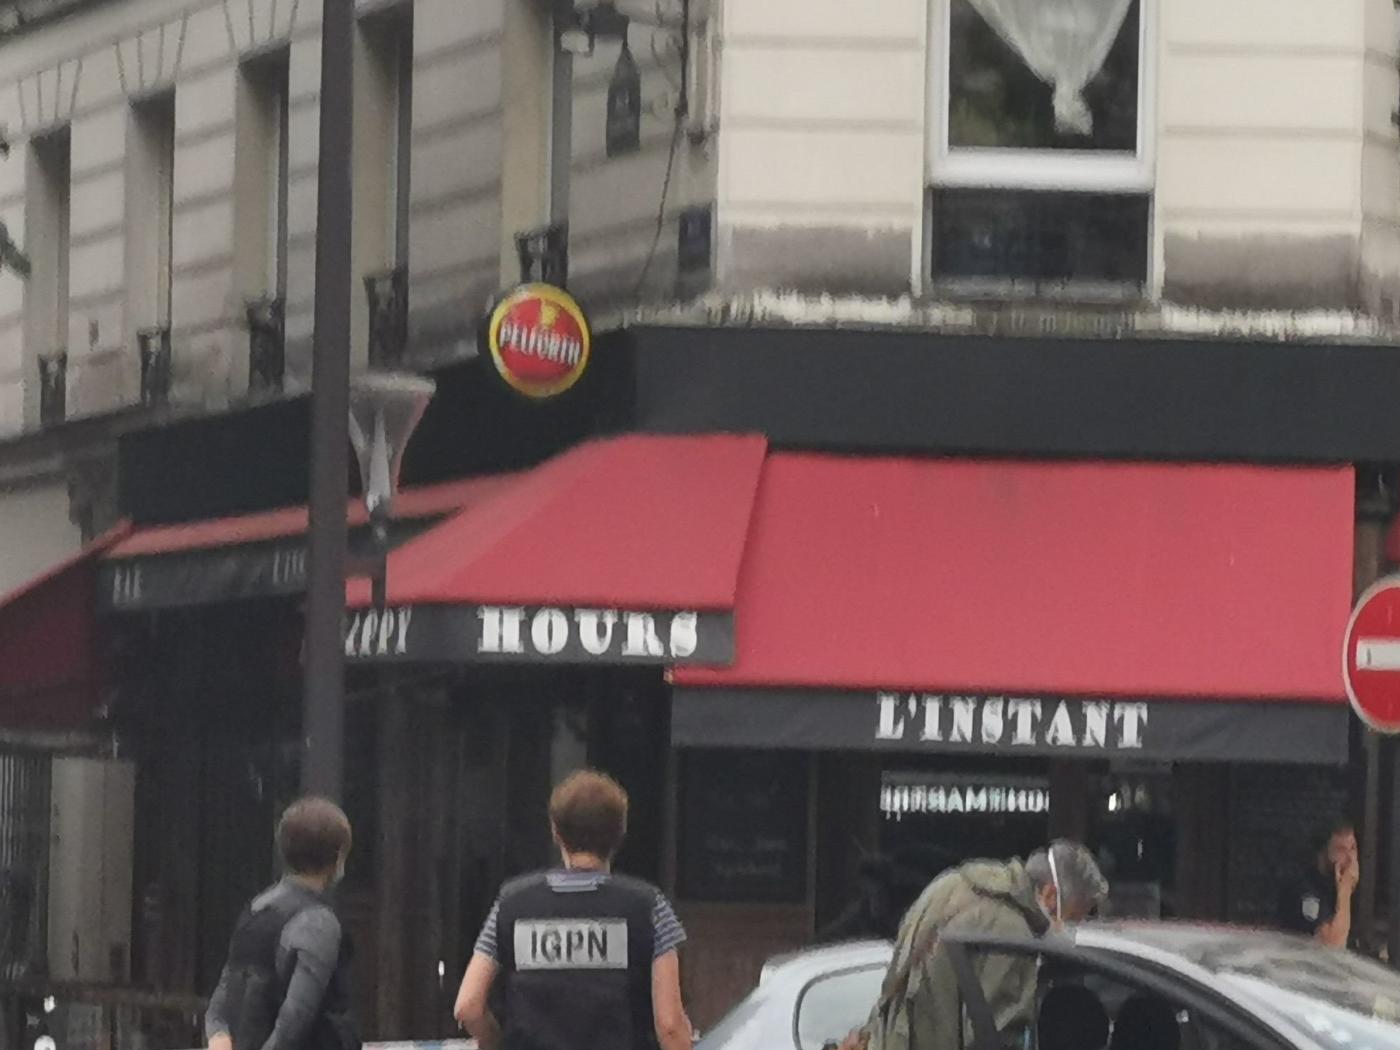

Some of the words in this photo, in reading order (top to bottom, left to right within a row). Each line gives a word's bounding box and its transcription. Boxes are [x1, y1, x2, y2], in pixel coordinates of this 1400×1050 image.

[477, 605, 698, 659] HOURS
[874, 690, 1149, 749] L'INSTANT
[530, 926, 608, 963] IGPN
